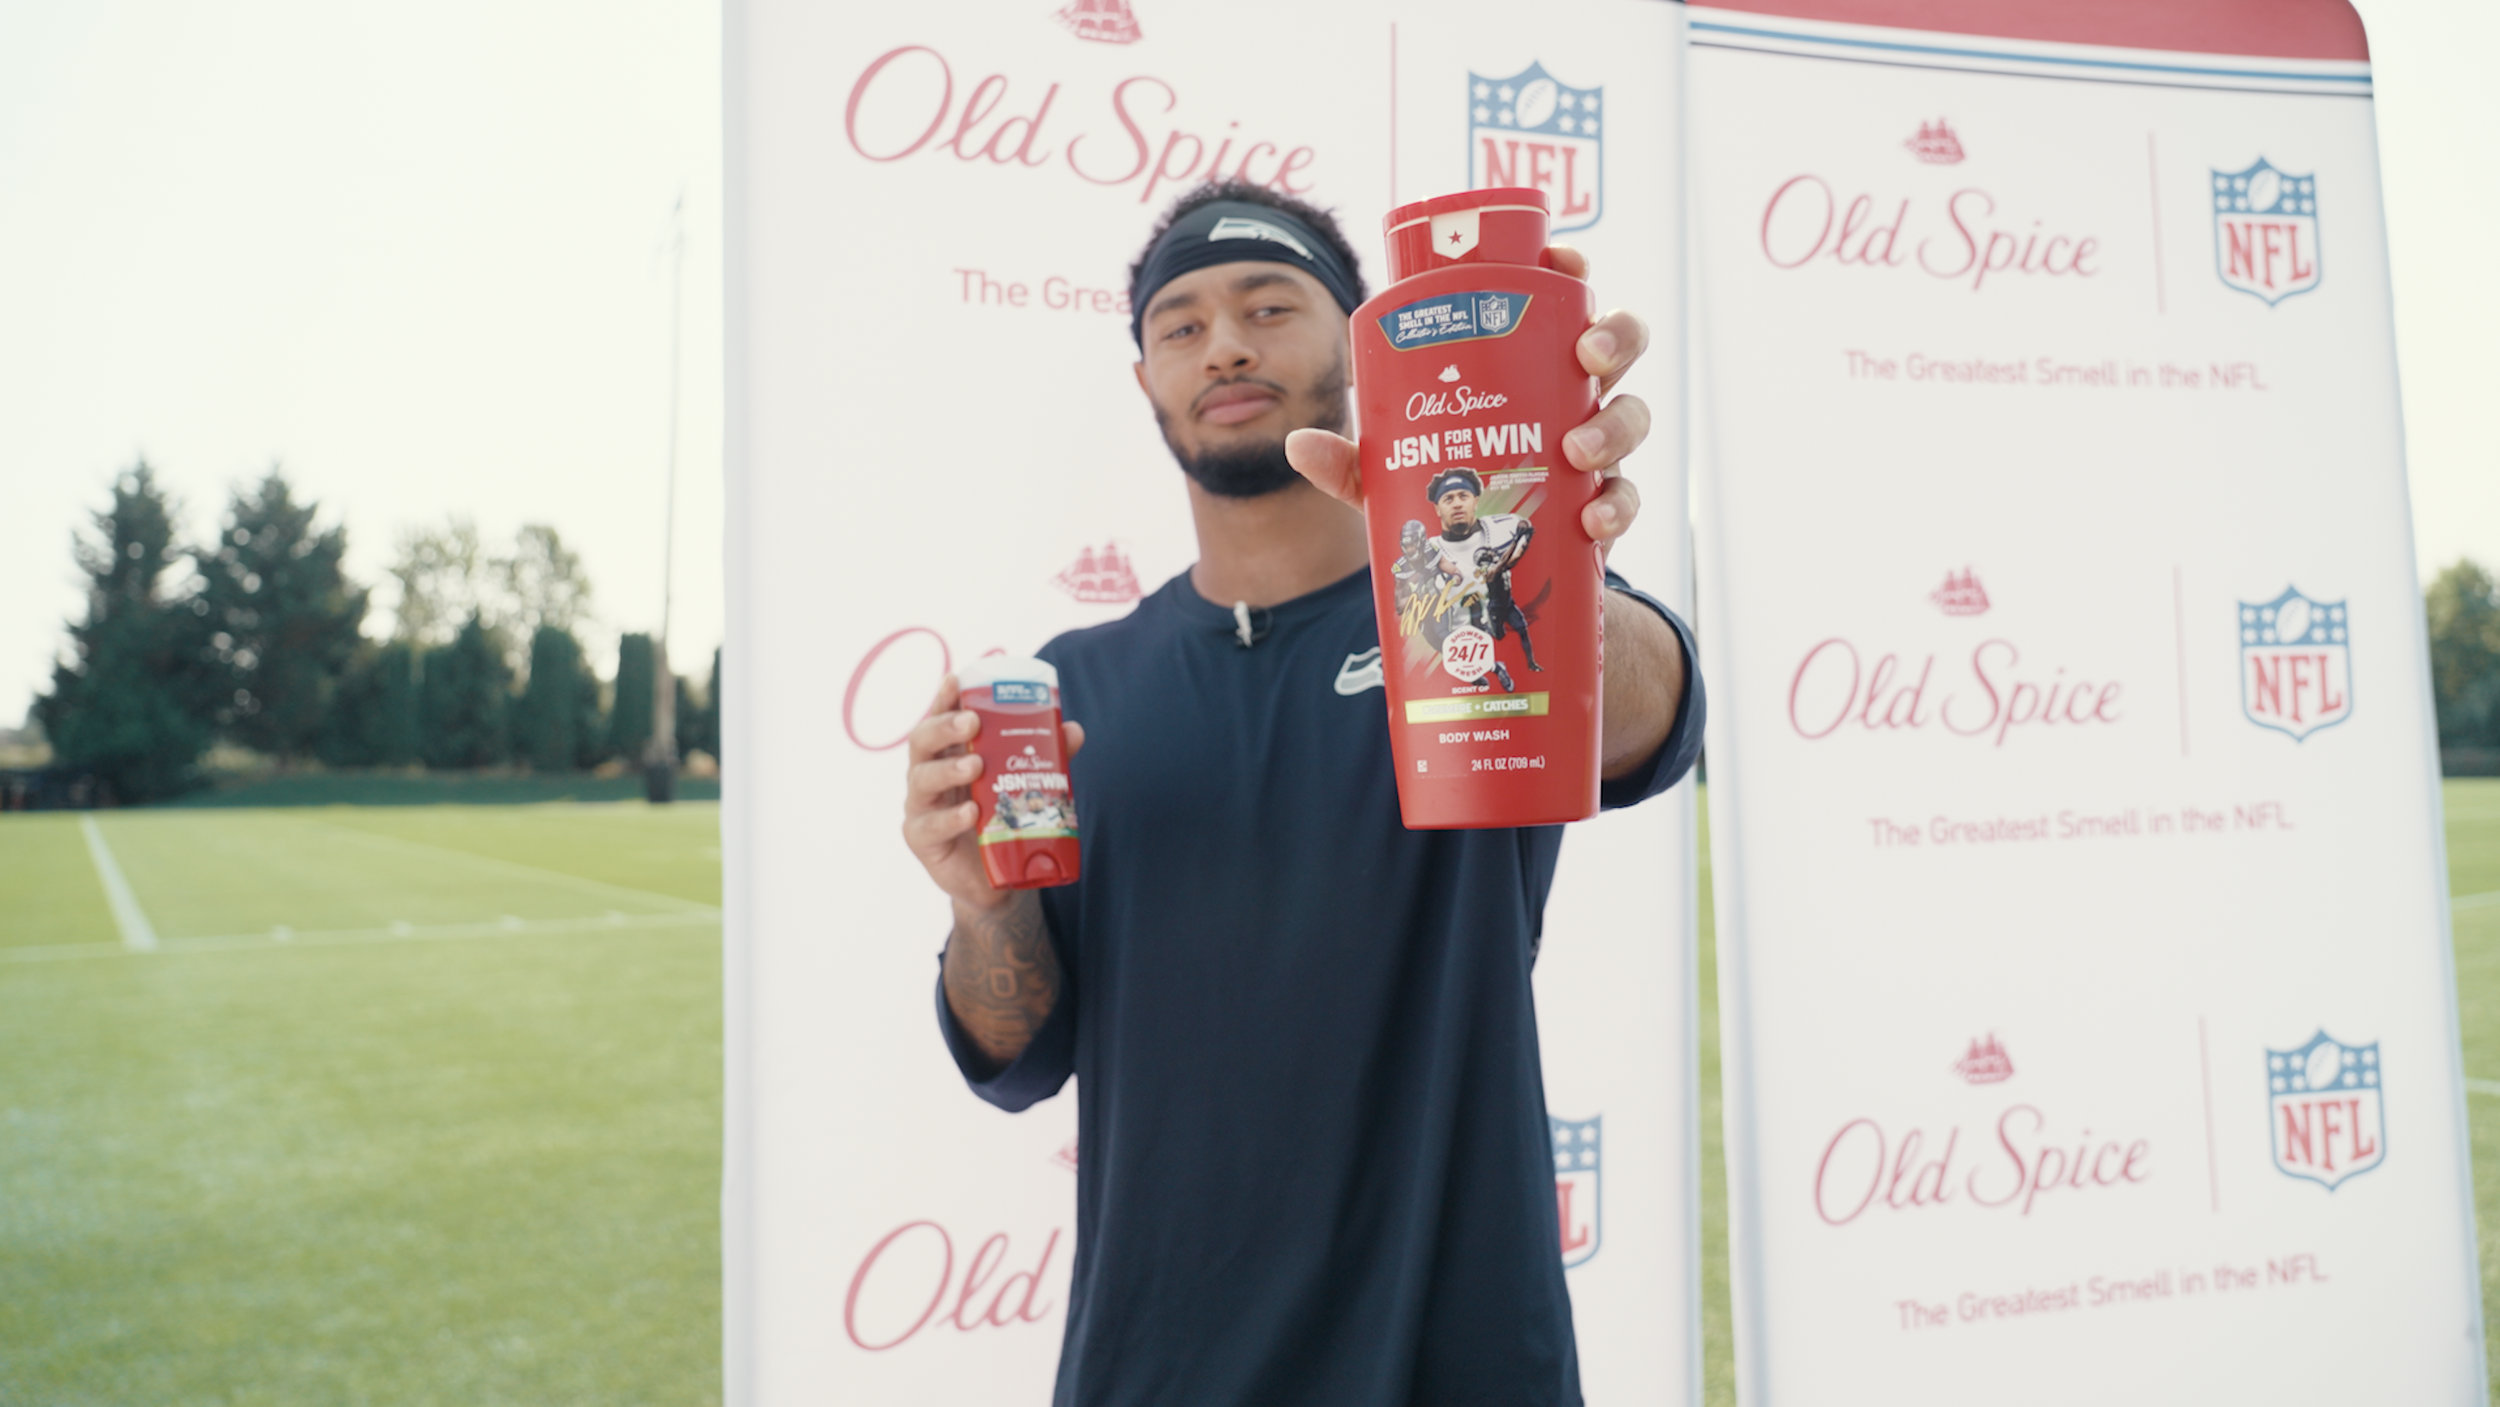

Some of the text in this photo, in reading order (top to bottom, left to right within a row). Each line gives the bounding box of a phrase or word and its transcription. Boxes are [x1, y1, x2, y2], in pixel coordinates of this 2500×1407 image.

[845, 45, 1316, 203] Old Spice
[1482, 137, 1590, 217] NFL
[1760, 174, 2101, 291] Old Spice
[2224, 221, 2312, 289] NFL
[953, 267, 1133, 315] The Grea
[1398, 304, 1452, 322] THE GREATEST
[1399, 310, 1468, 331] SMELL IN THE NFL
[1484, 310, 1507, 326] NFL
[1844, 350, 2268, 391] The Greatest Smell in the NFL
[1405, 385, 1504, 421] Old Spice
[1385, 422, 1542, 471] JSN FOR THE WIN
[1447, 642, 1489, 663] 24/7
[1451, 630, 1484, 643] SHOWER
[1452, 686, 1477, 694] SCENT
[1455, 666, 1483, 677] FRESH
[1787, 637, 2122, 747] Old Spice
[2250, 653, 2341, 724] NFL
[1483, 699, 1528, 712] CATCHES
[1439, 730, 1510, 744] BODY WASH
[992, 773, 1027, 793] JSN
[1041, 771, 1069, 791] WIN
[1006, 755, 1029, 772] Old
[1471, 755, 1545, 771] 24 FL OZ (709 mL)
[1870, 801, 2294, 847] The Greatest Smell in the NFL
[2280, 1098, 2375, 1172] NFL
[1813, 1103, 2151, 1226] Old Spice
[844, 1219, 1062, 1352] Old
[1896, 1252, 2329, 1331] The Greatest Smell in the NFL
